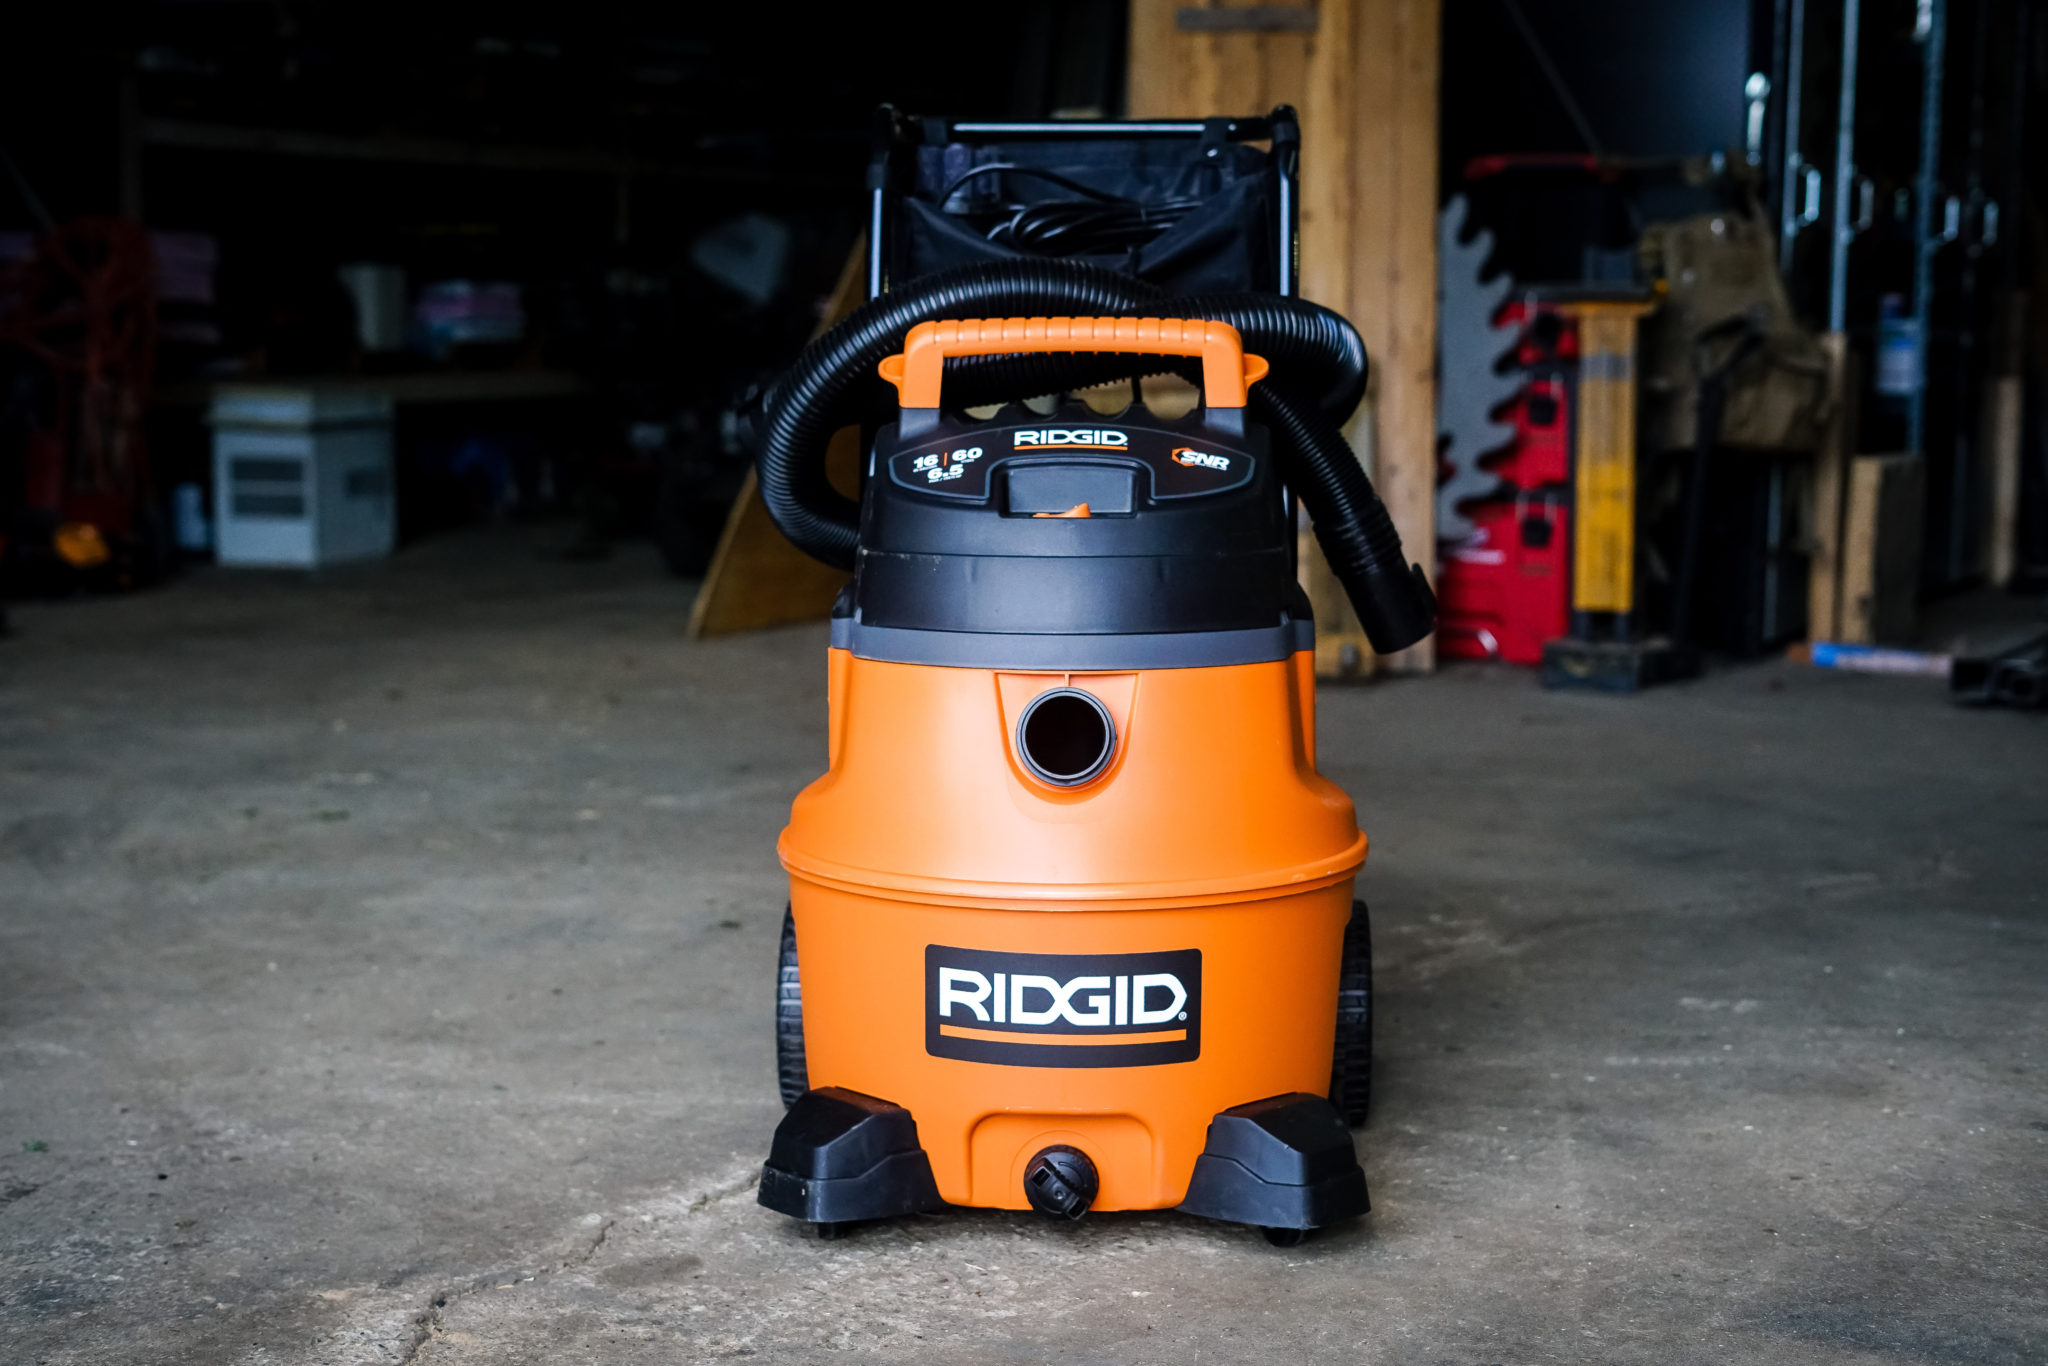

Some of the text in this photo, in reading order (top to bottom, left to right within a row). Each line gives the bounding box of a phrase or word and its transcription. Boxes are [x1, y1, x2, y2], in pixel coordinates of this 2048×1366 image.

[1014, 429, 1128, 446] RIDGID
[913, 454, 939, 469] 16
[952, 447, 983, 462] 60
[1180, 450, 1231, 471] SNR
[927, 463, 964, 480] 6.5
[939, 966, 1188, 1026] RIDGID
